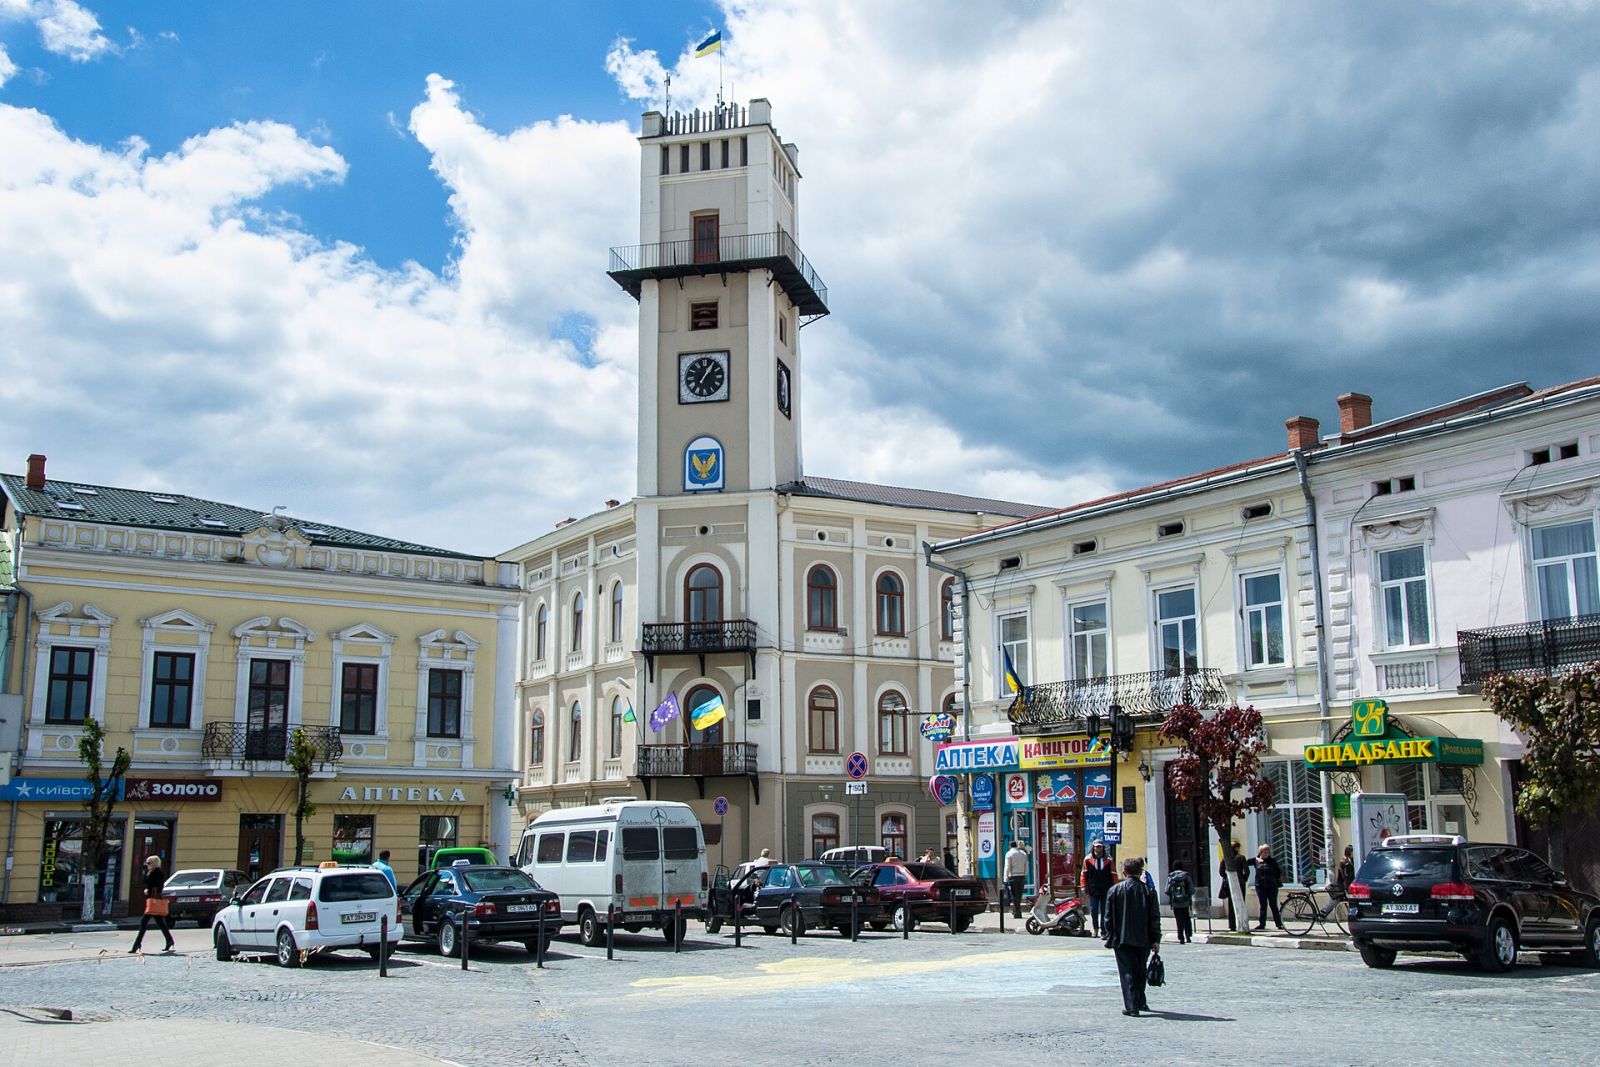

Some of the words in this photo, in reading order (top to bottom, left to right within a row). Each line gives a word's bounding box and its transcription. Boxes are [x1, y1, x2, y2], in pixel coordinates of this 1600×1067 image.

[936, 744, 1016, 768] АПТЕКА
[1024, 737, 1111, 759] КАНЦТОВ
[1304, 740, 1433, 766] ОЩАДБАНК
[36, 784, 108, 796] КИЇВСТ
[339, 786, 467, 802] АПТЕКА
[941, 786, 952, 796] 24
[1010, 780, 1023, 792] 24
